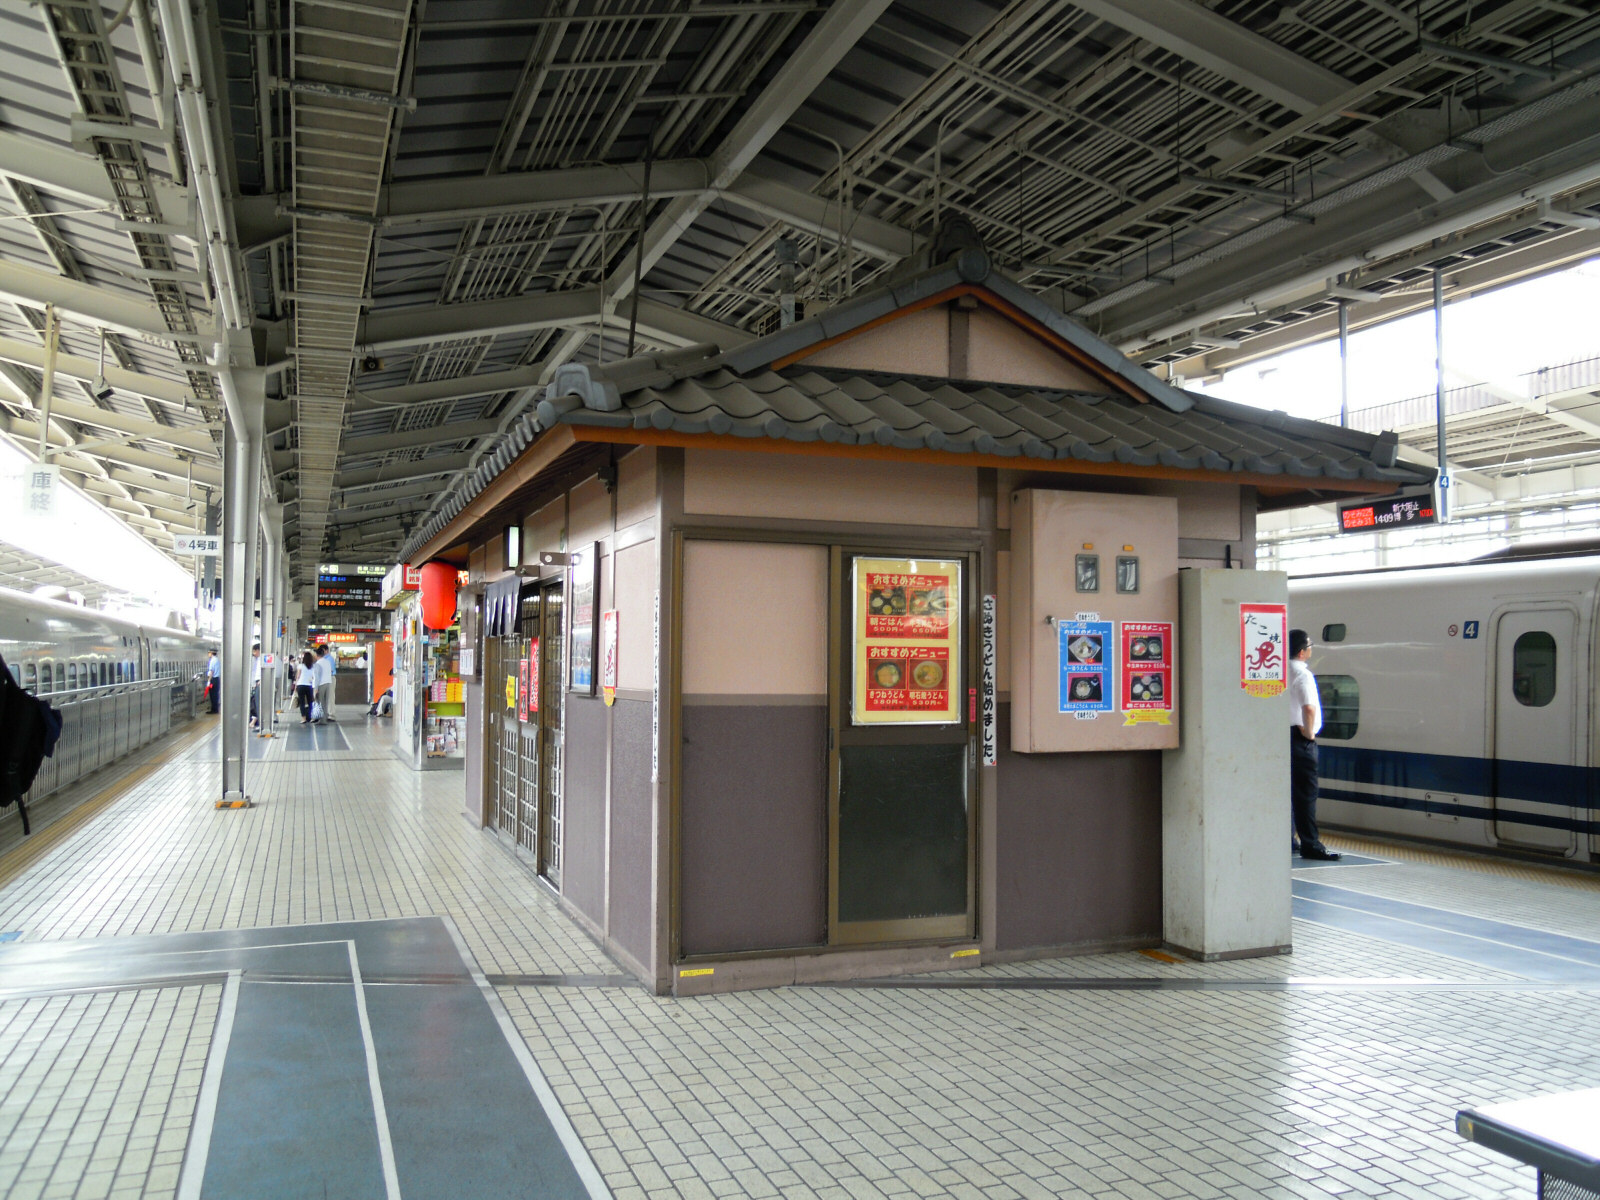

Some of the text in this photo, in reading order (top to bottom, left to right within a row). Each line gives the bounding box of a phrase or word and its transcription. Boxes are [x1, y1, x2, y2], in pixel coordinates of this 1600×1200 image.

[1441, 477, 1448, 488] 4
[1392, 501, 1420, 512] 新大阪止
[188, 540, 218, 550] 4号車
[873, 574, 943, 586] おすすめメニュー
[1464, 623, 1476, 637] 4
[870, 647, 947, 658] おすすめメニュー
[869, 690, 905, 699] きつねうどん
